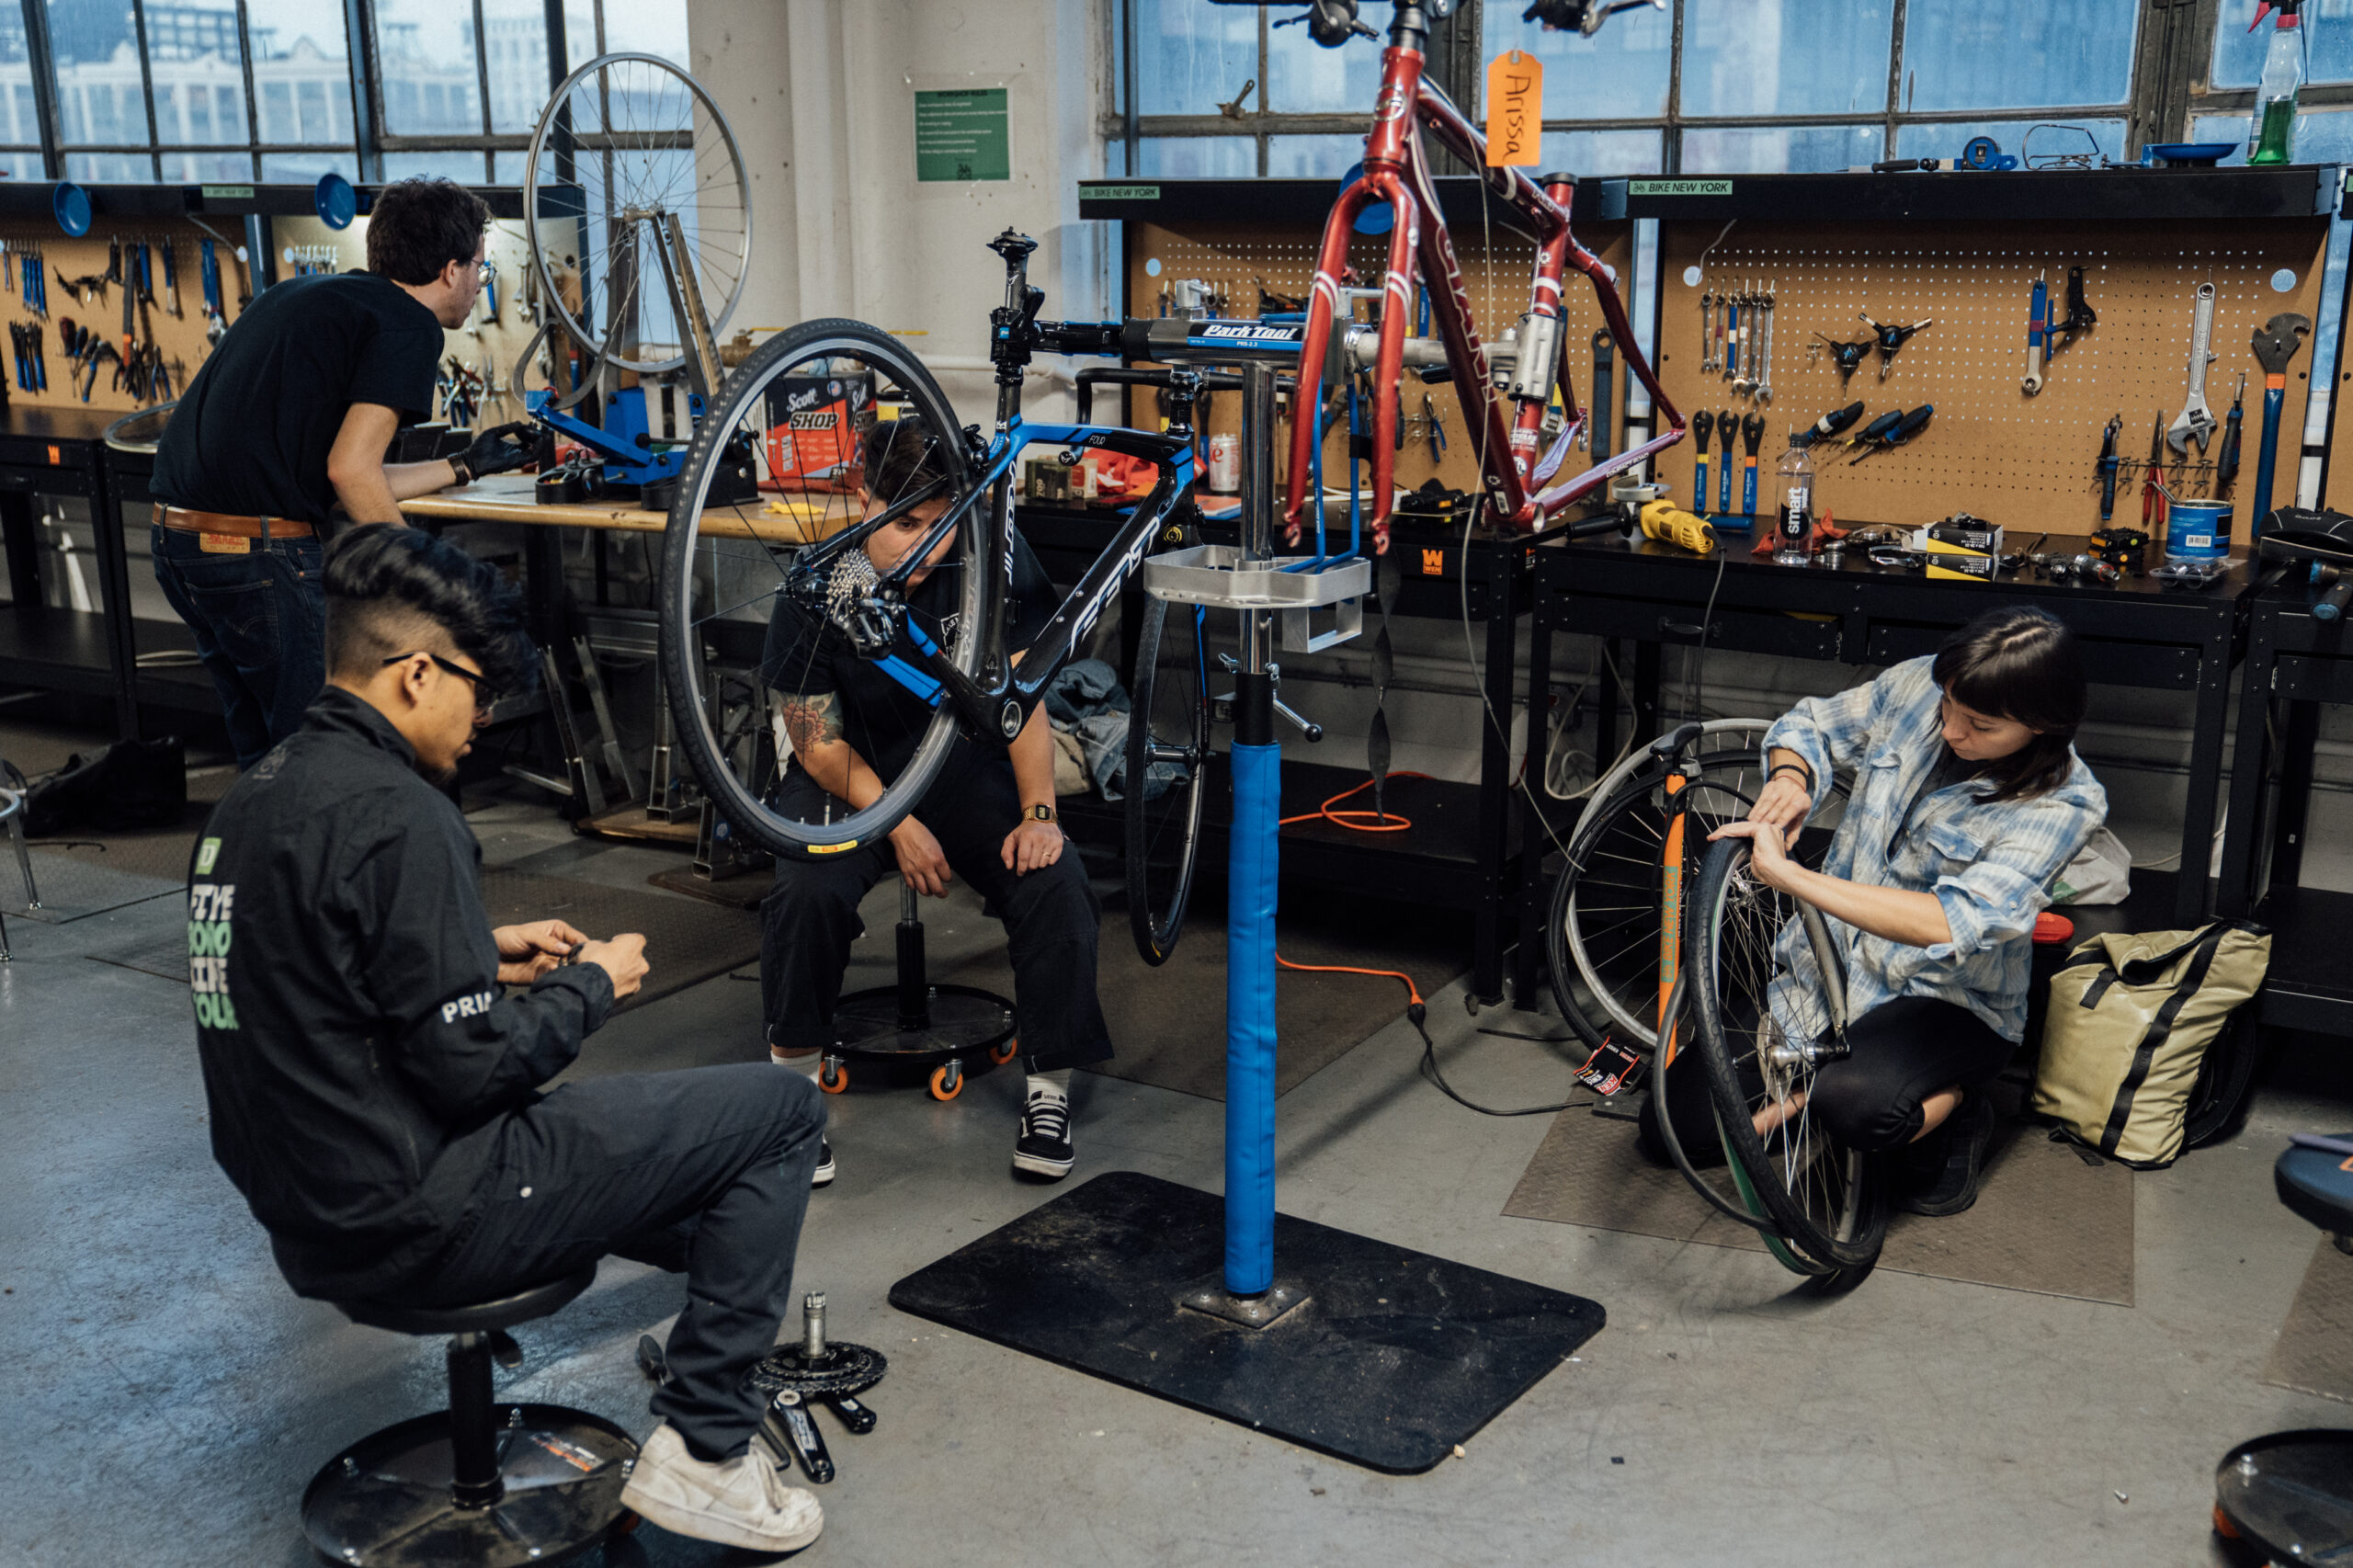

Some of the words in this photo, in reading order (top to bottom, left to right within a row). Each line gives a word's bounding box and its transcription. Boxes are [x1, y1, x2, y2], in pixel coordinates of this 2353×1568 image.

[1503, 74, 1531, 161] Arissa
[1094, 188, 1111, 197] BIKE
[1112, 188, 1133, 197] NEW
[1134, 188, 1156, 197] YORK
[1648, 183, 1670, 193] BIKE
[1672, 183, 1697, 193] NEW
[1699, 183, 1728, 193] YORK
[1202, 324, 1250, 339] Park
[1248, 326, 1299, 341] Tool
[787, 387, 818, 412] Scott
[790, 411, 839, 430] SHOP
[1089, 436, 1106, 446] FOUR
[1788, 487, 1802, 534] smart
[1665, 869, 1677, 902] YORK
[1663, 905, 1676, 935] NEW
[1663, 936, 1675, 962] BIKE
